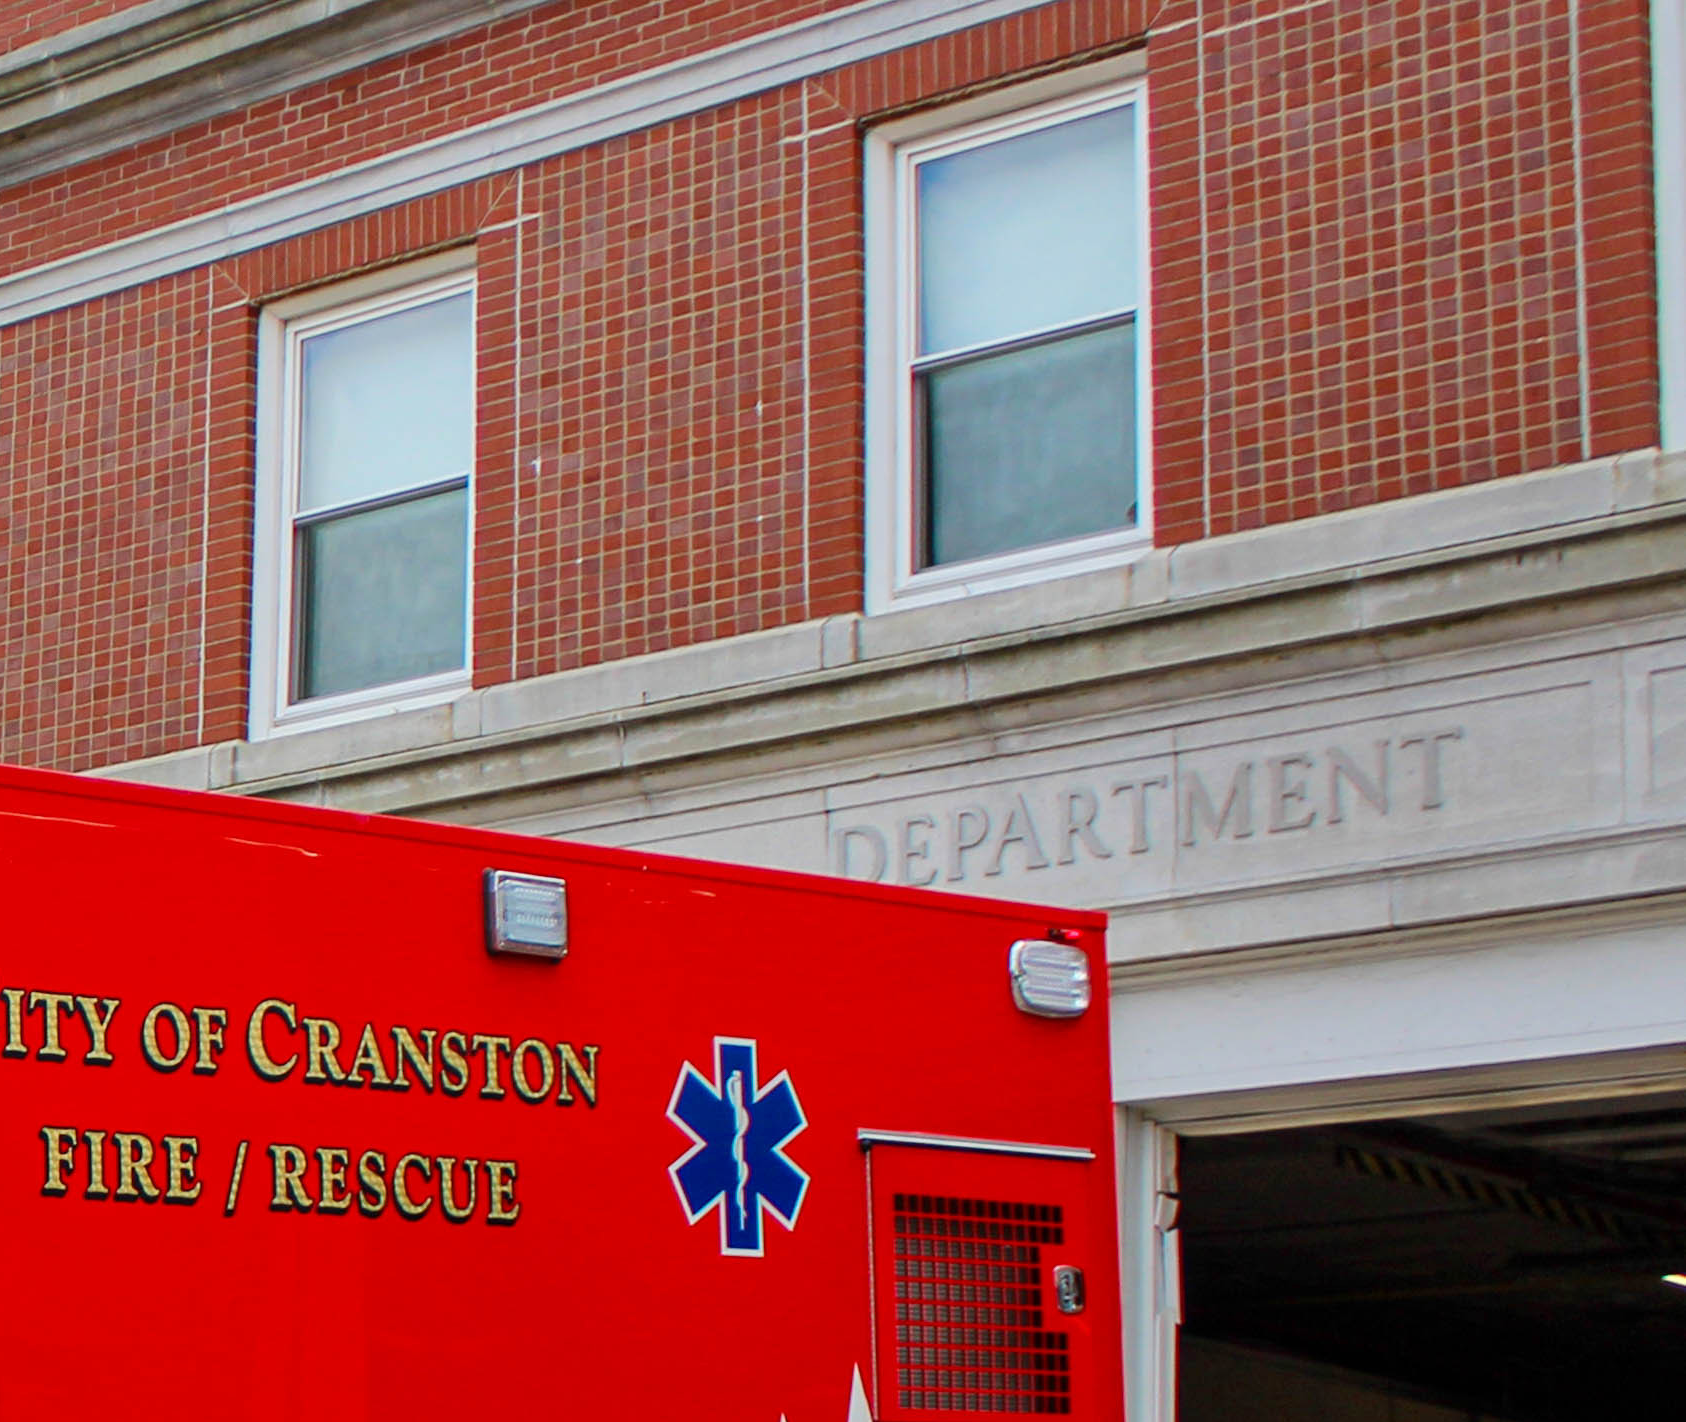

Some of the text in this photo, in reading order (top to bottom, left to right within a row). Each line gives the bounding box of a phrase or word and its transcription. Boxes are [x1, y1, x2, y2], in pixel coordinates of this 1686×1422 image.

[832, 727, 1464, 886] DEPARTMENT
[140, 1003, 227, 1075] OF
[247, 999, 601, 1107] CRANSTON
[38, 1125, 521, 1225] FIRE / RESCUE
